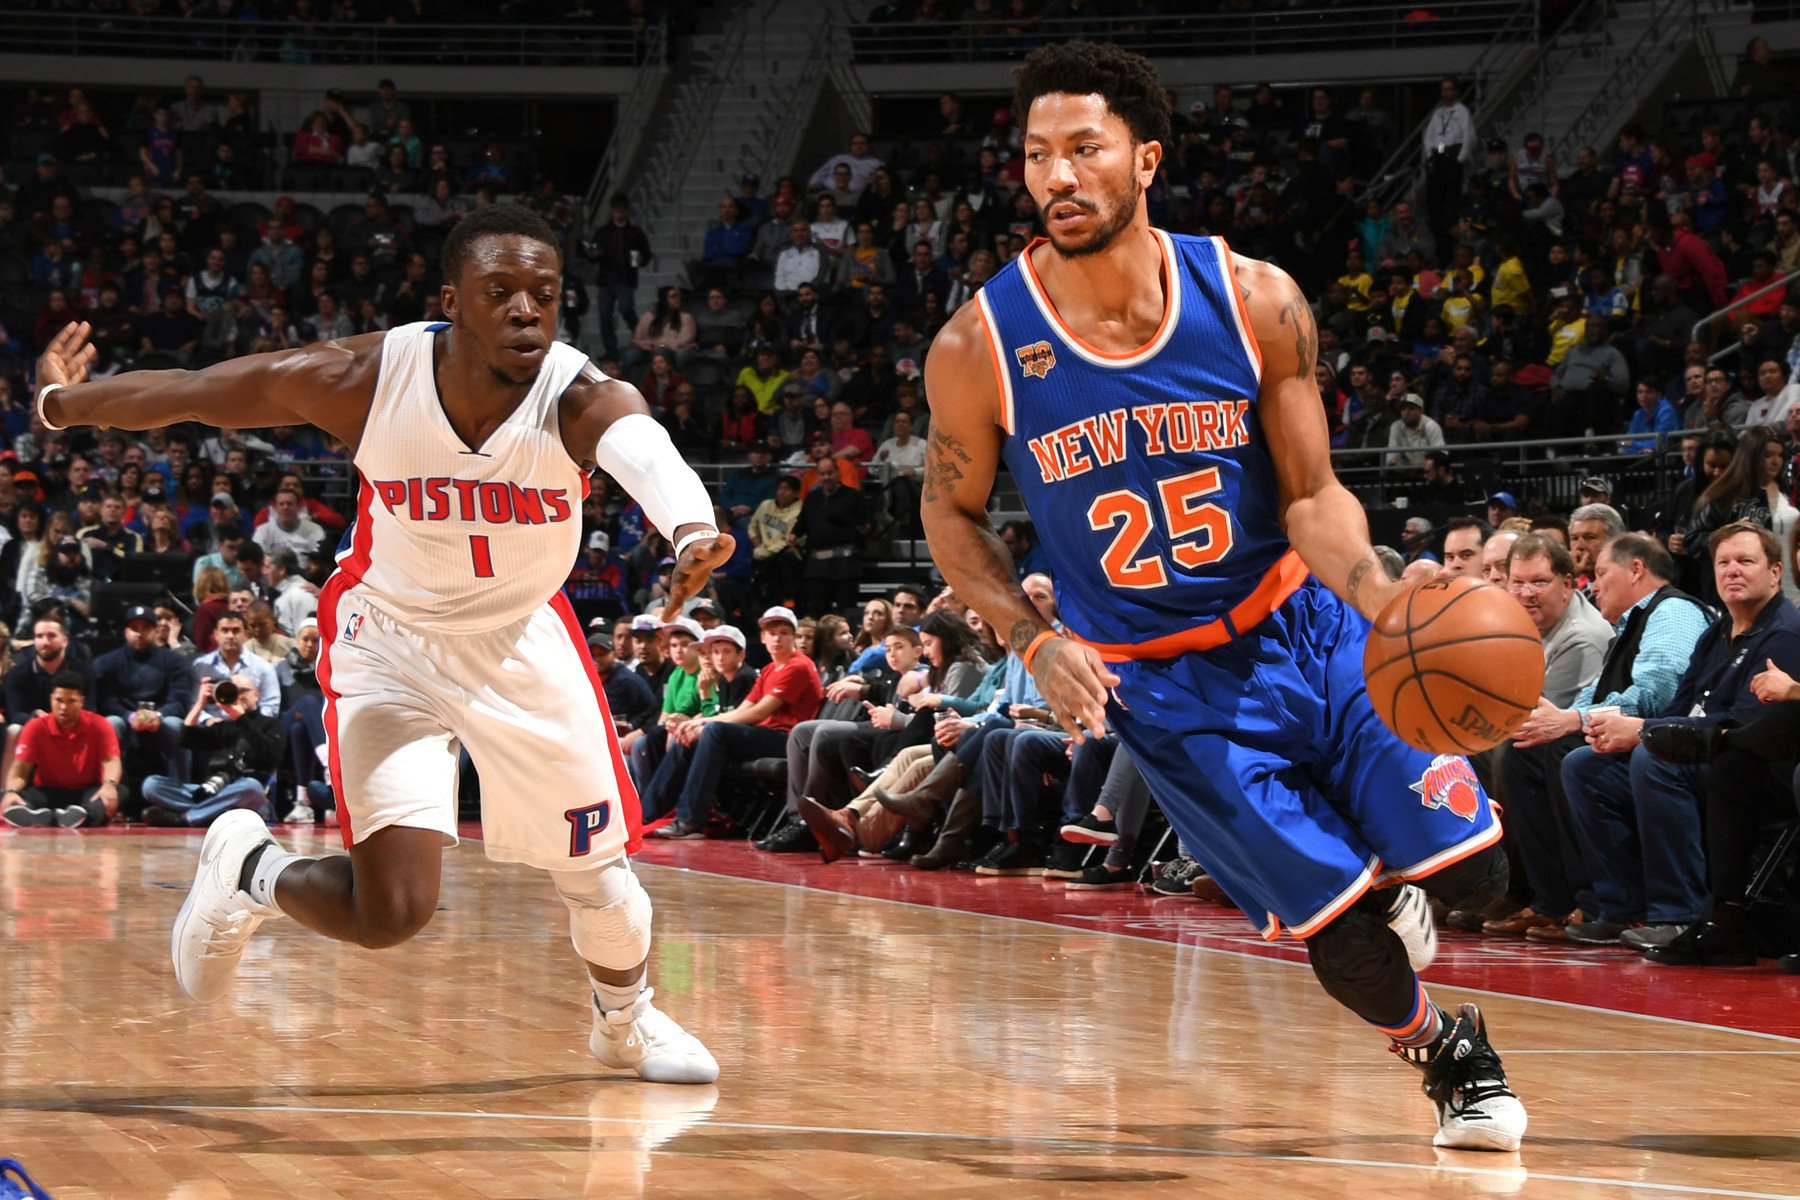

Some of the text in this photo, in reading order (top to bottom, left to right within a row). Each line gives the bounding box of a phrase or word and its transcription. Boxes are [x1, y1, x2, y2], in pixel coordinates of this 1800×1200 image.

[1028, 409, 1127, 483] NEW
[1132, 399, 1249, 455] YORK
[373, 477, 572, 525] PISTONS
[1087, 467, 1233, 588] 25
[469, 535, 495, 578] 1
